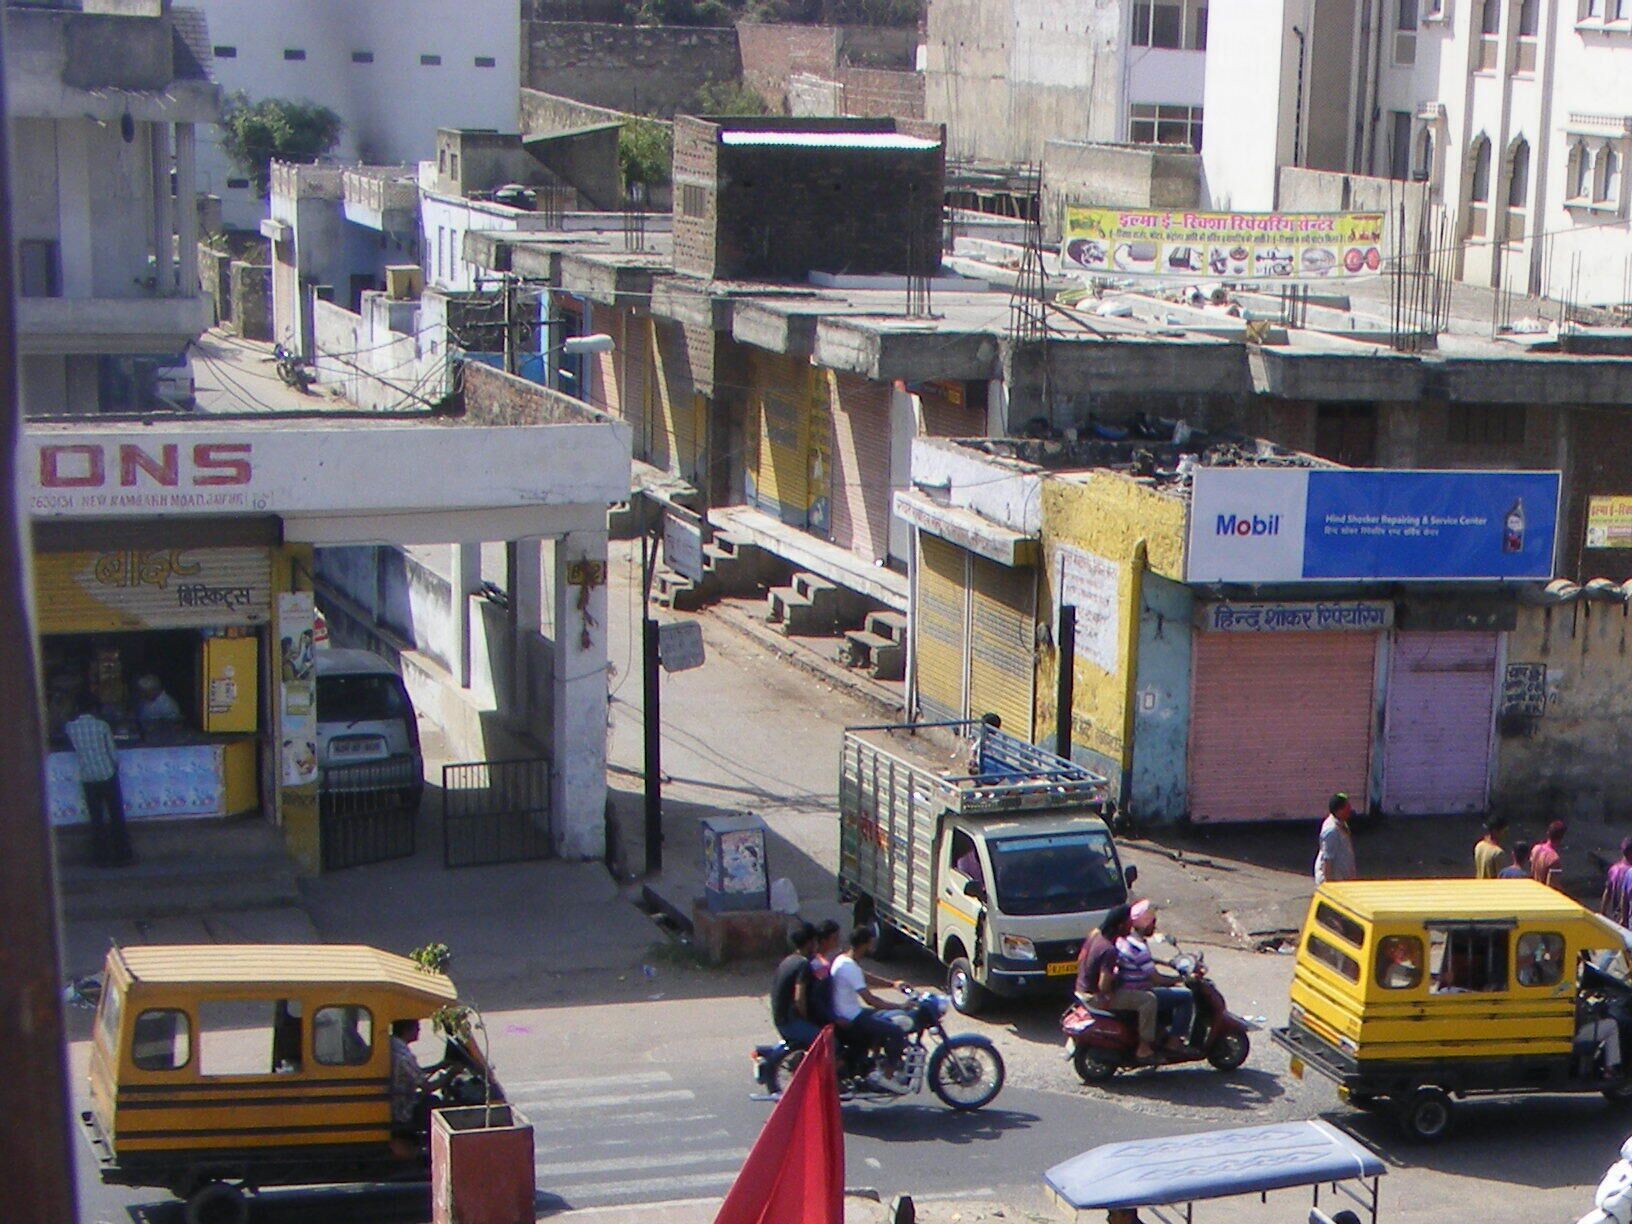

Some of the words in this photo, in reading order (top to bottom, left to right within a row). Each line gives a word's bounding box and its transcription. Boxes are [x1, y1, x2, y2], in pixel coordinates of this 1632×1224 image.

[39, 443, 253, 488] ONS
[1216, 514, 1281, 537] Mobil
[1325, 514, 1346, 524] Hind
[1381, 515, 1420, 527] Repairing
[1430, 516, 1459, 526] Service
[1459, 515, 1488, 526] Center
[1264, 604, 1314, 629] शोकर
